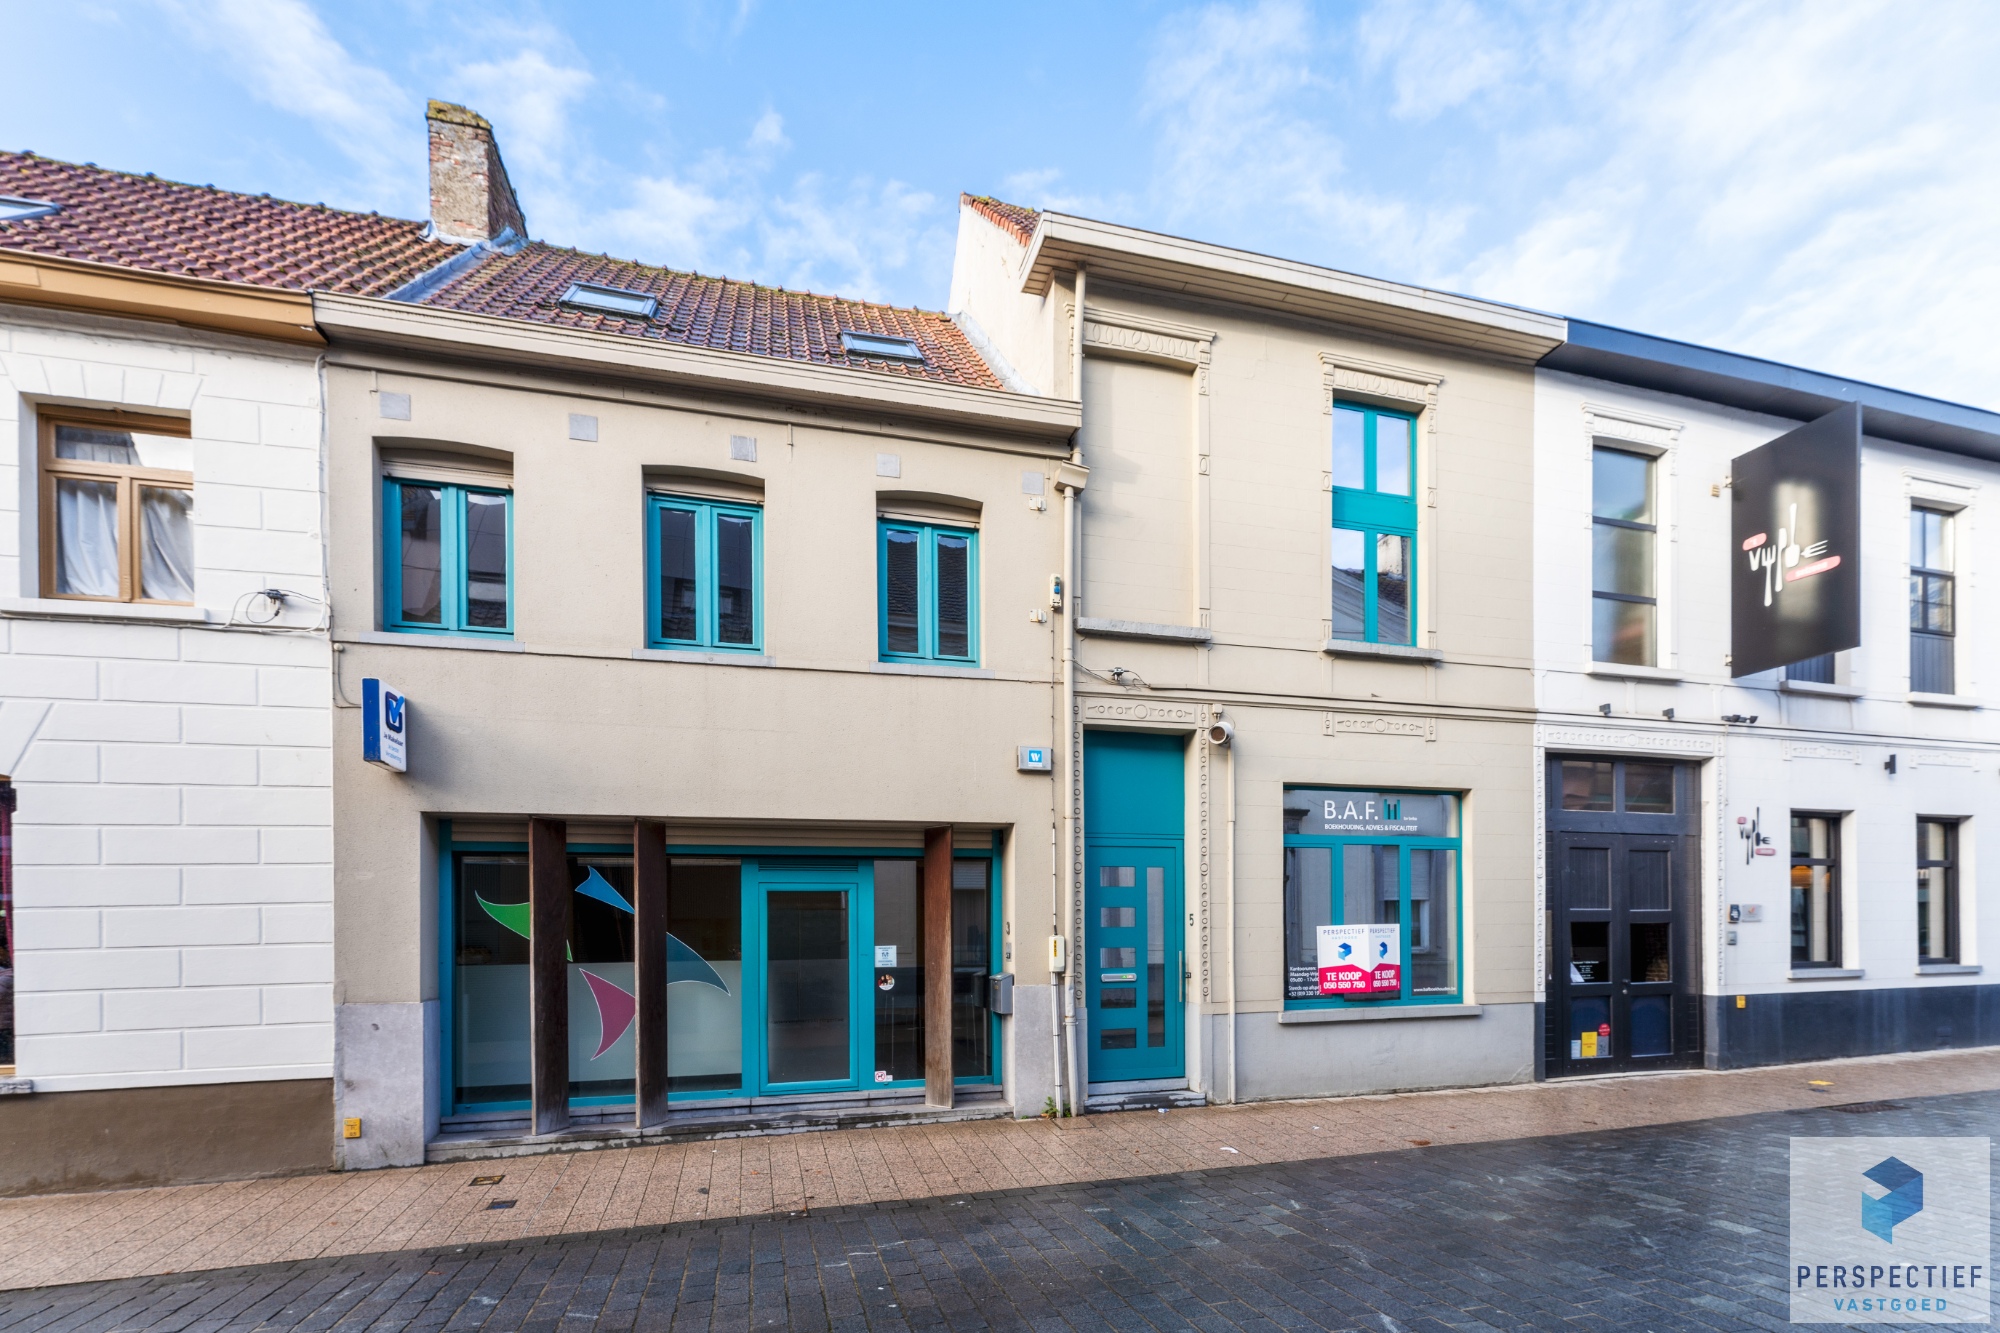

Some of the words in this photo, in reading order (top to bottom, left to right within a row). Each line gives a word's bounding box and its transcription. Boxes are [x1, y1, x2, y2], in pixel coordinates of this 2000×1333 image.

[1324, 800, 1379, 820] B.A.F.
[1189, 913, 1194, 926] 5
[1006, 921, 1011, 935] 3
[1326, 972, 1337, 981] TE
[1338, 971, 1362, 981] KOOP
[1374, 970, 1381, 979] TE
[1382, 969, 1395, 979] KOOP
[1338, 981, 1351, 989] 550
[1373, 980, 1382, 988] 050
[1389, 979, 1397, 987] 750
